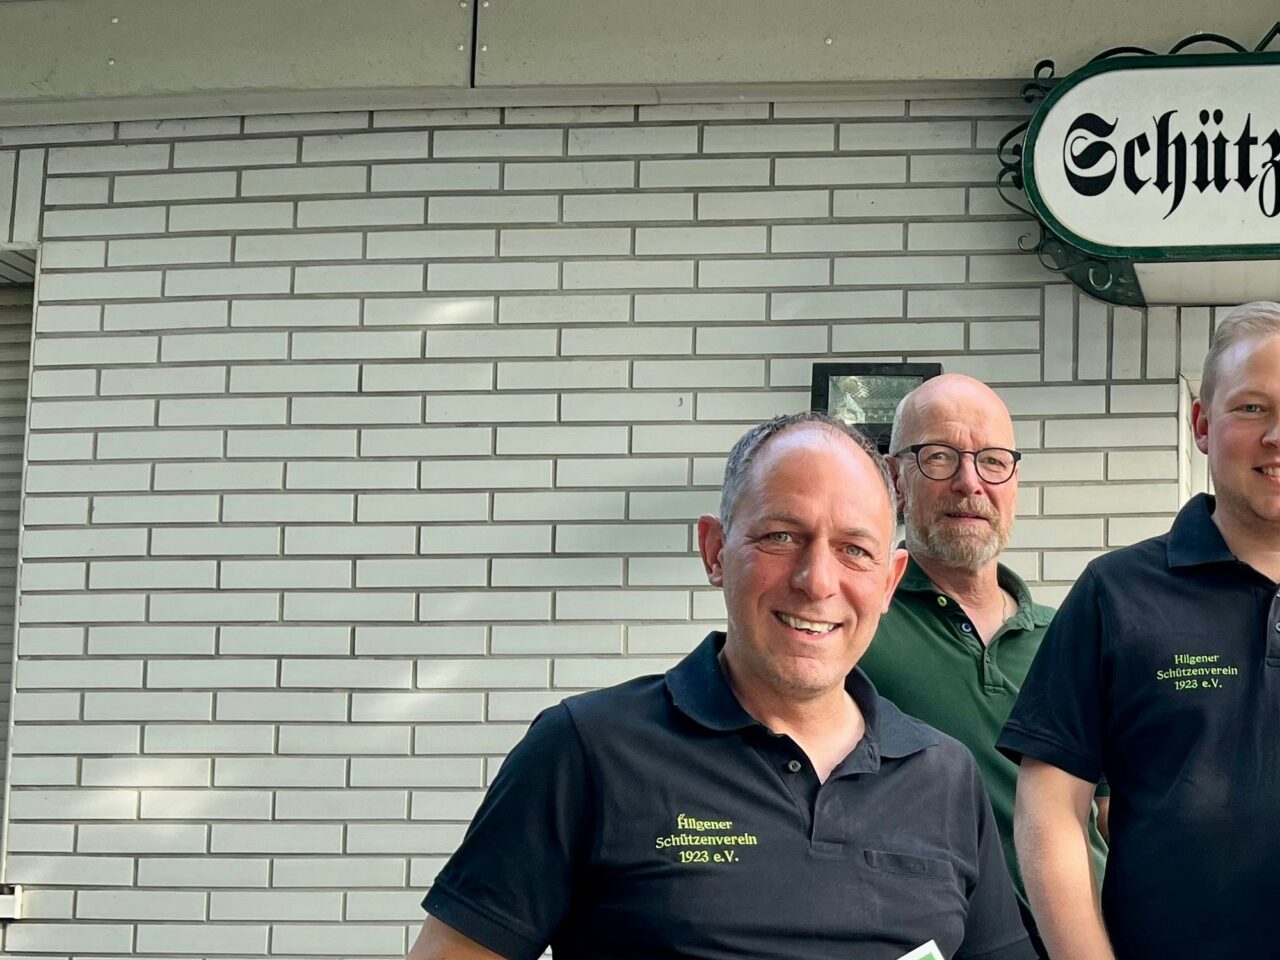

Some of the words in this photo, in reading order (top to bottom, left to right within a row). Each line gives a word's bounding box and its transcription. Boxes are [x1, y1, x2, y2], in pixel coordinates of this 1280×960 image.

[1174, 654, 1219, 665] Hilgener
[1156, 666, 1238, 680] Schützenverein
[1174, 680, 1198, 690] 1923
[1202, 678, 1222, 688] e.V.
[655, 833, 757, 848] Schützenverein
[679, 851, 709, 863] 1923
[713, 851, 740, 862] e.V.
